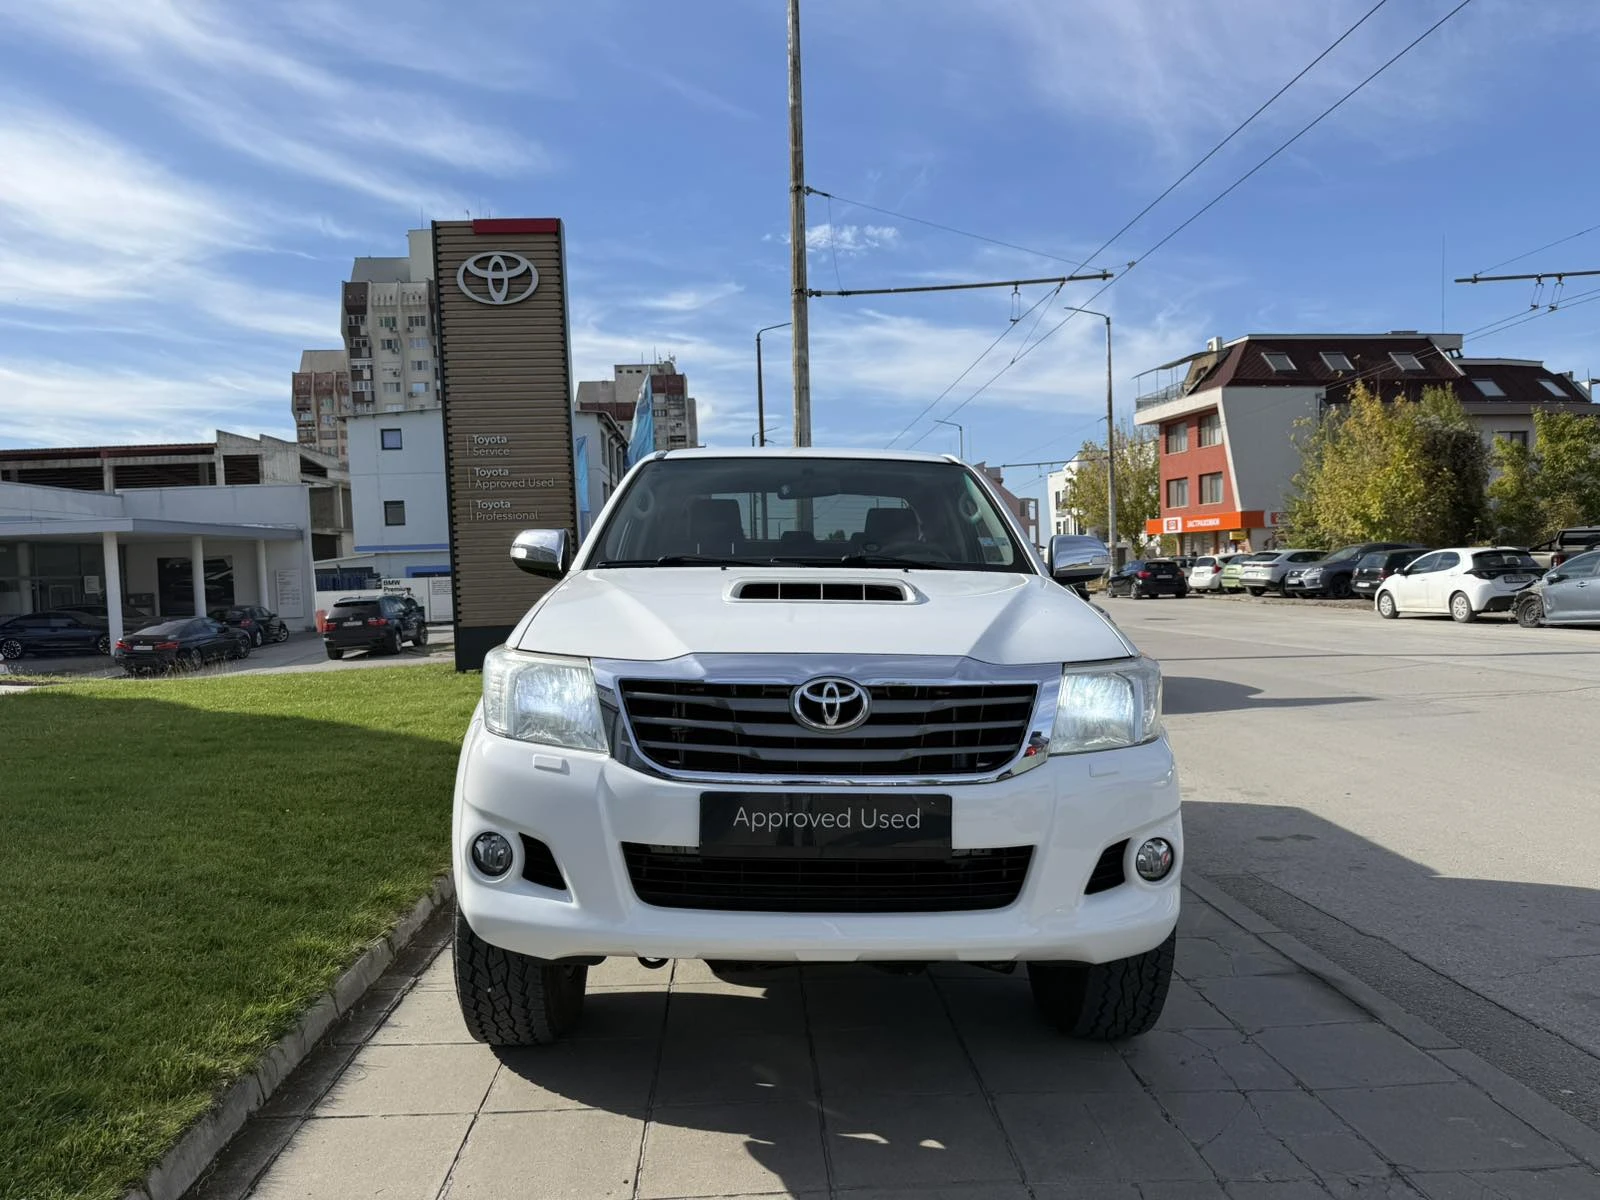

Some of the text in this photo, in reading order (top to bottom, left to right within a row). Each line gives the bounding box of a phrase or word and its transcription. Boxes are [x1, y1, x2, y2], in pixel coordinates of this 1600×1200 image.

[472, 434, 508, 446] Toyota
[473, 447, 510, 456] Service
[474, 467, 509, 478] Toyota
[475, 477, 554, 489] Approved Used
[476, 499, 511, 510] Toyota
[476, 509, 538, 521] Professional
[732, 806, 921, 832] Approved Used
